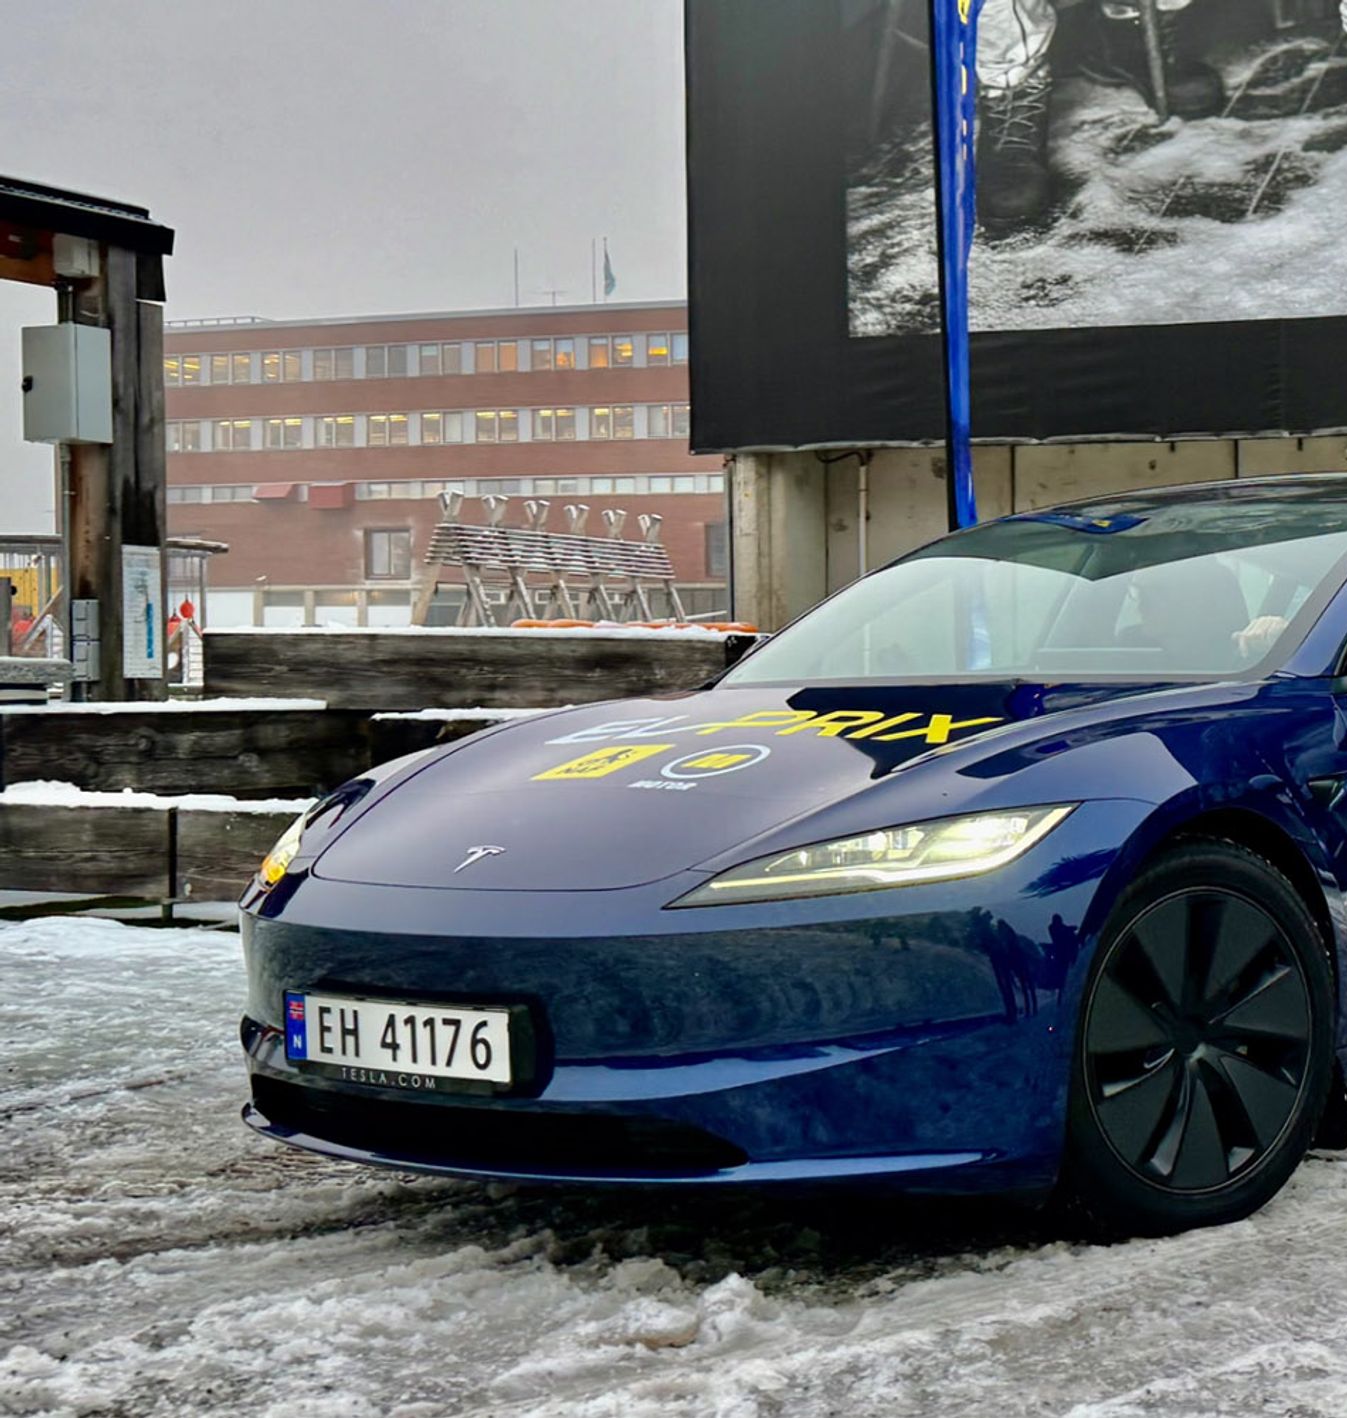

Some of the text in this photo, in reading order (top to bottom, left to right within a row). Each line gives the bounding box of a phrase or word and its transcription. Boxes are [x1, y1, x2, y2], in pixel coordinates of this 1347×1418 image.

[293, 1035, 302, 1049] N
[318, 1006, 492, 1070] EH 41176
[342, 1067, 436, 1088] TESLA.COM
